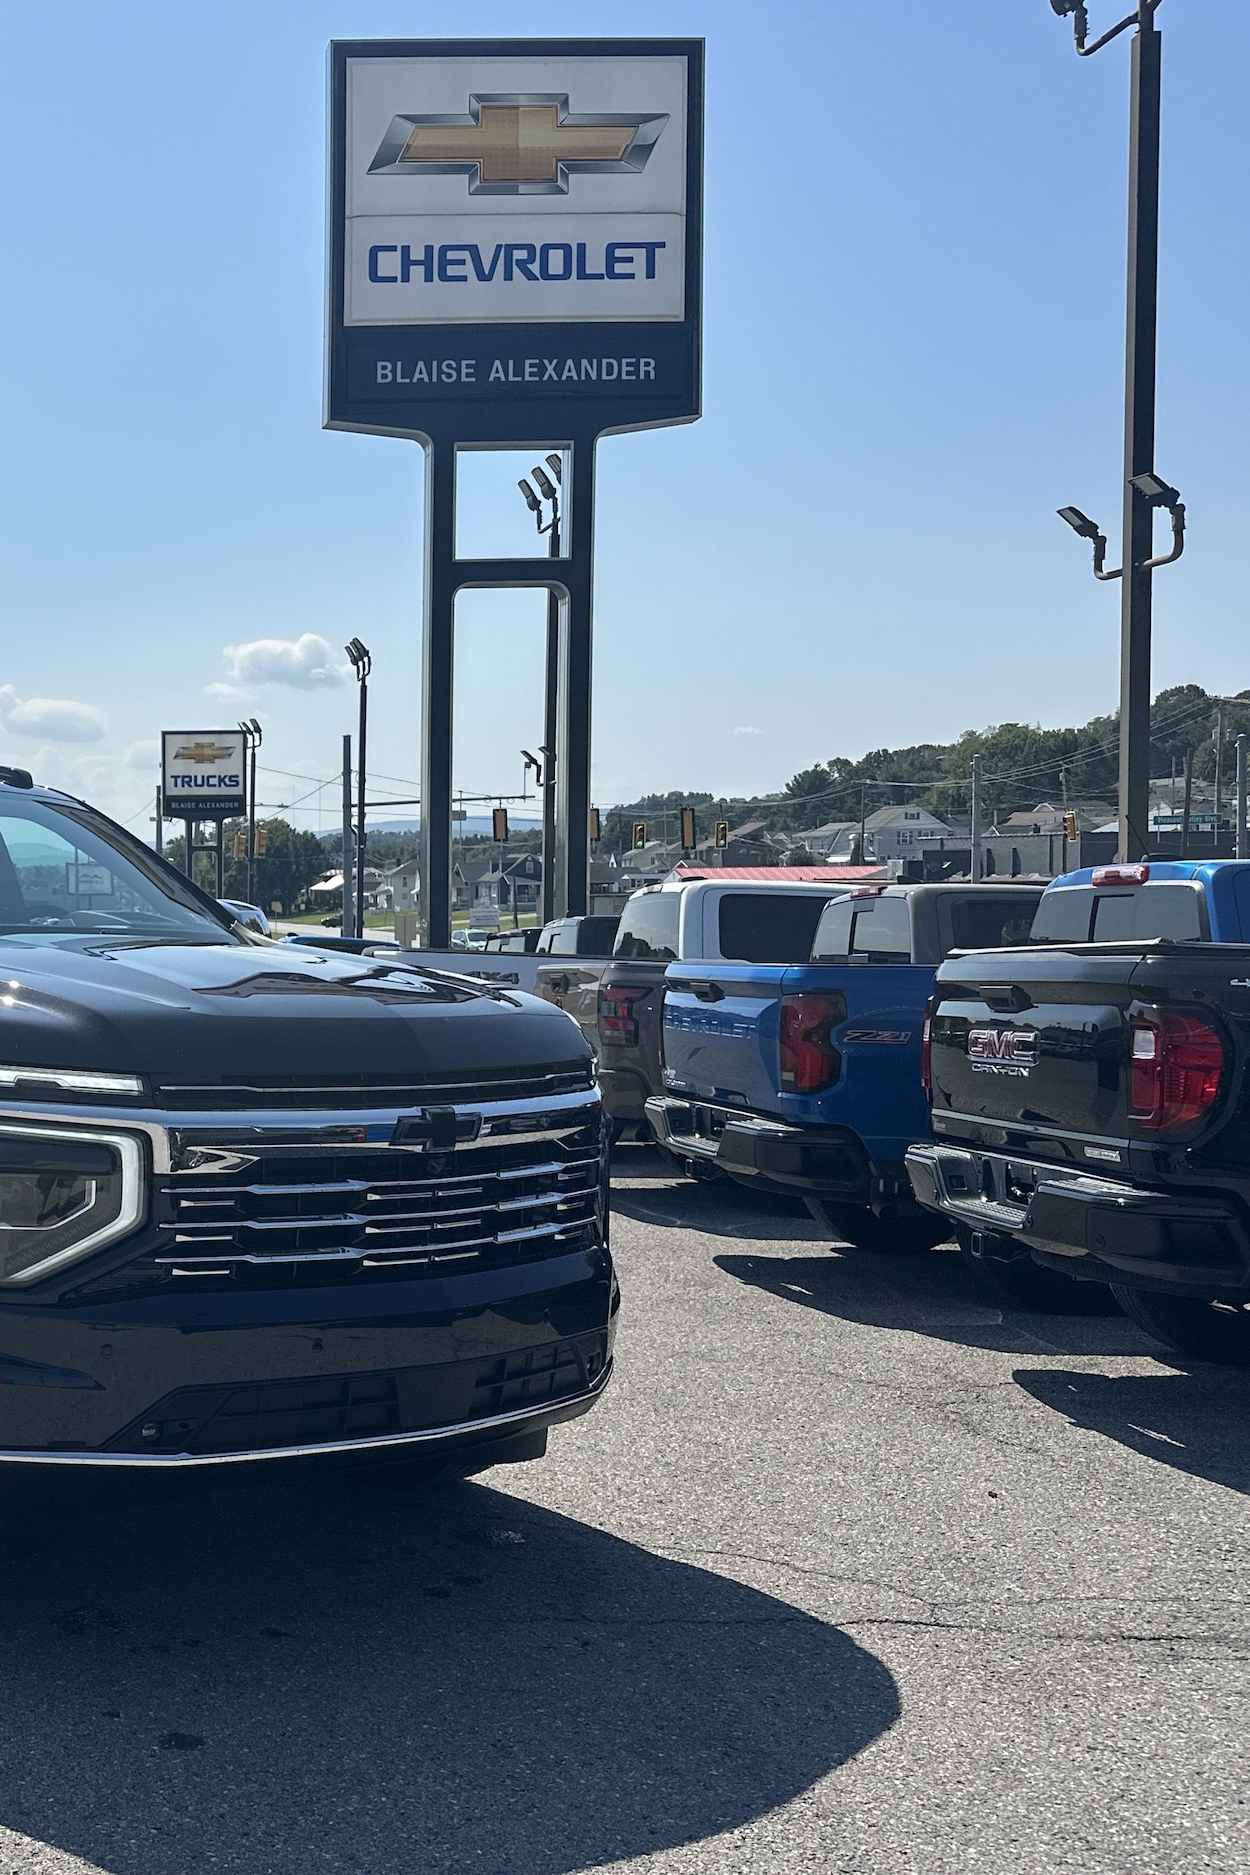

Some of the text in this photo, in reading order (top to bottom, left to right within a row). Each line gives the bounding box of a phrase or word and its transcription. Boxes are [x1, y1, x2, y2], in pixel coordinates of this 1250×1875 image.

[368, 242, 666, 283] CHEVROLET
[376, 357, 656, 383] BLAISE ALEXANDER
[170, 774, 239, 788] TRUCKS
[198, 801, 239, 809] ALEXANDER
[842, 1029, 912, 1045] Z71
[968, 1029, 1037, 1061] GMC
[971, 1063, 1030, 1078] CANYON
